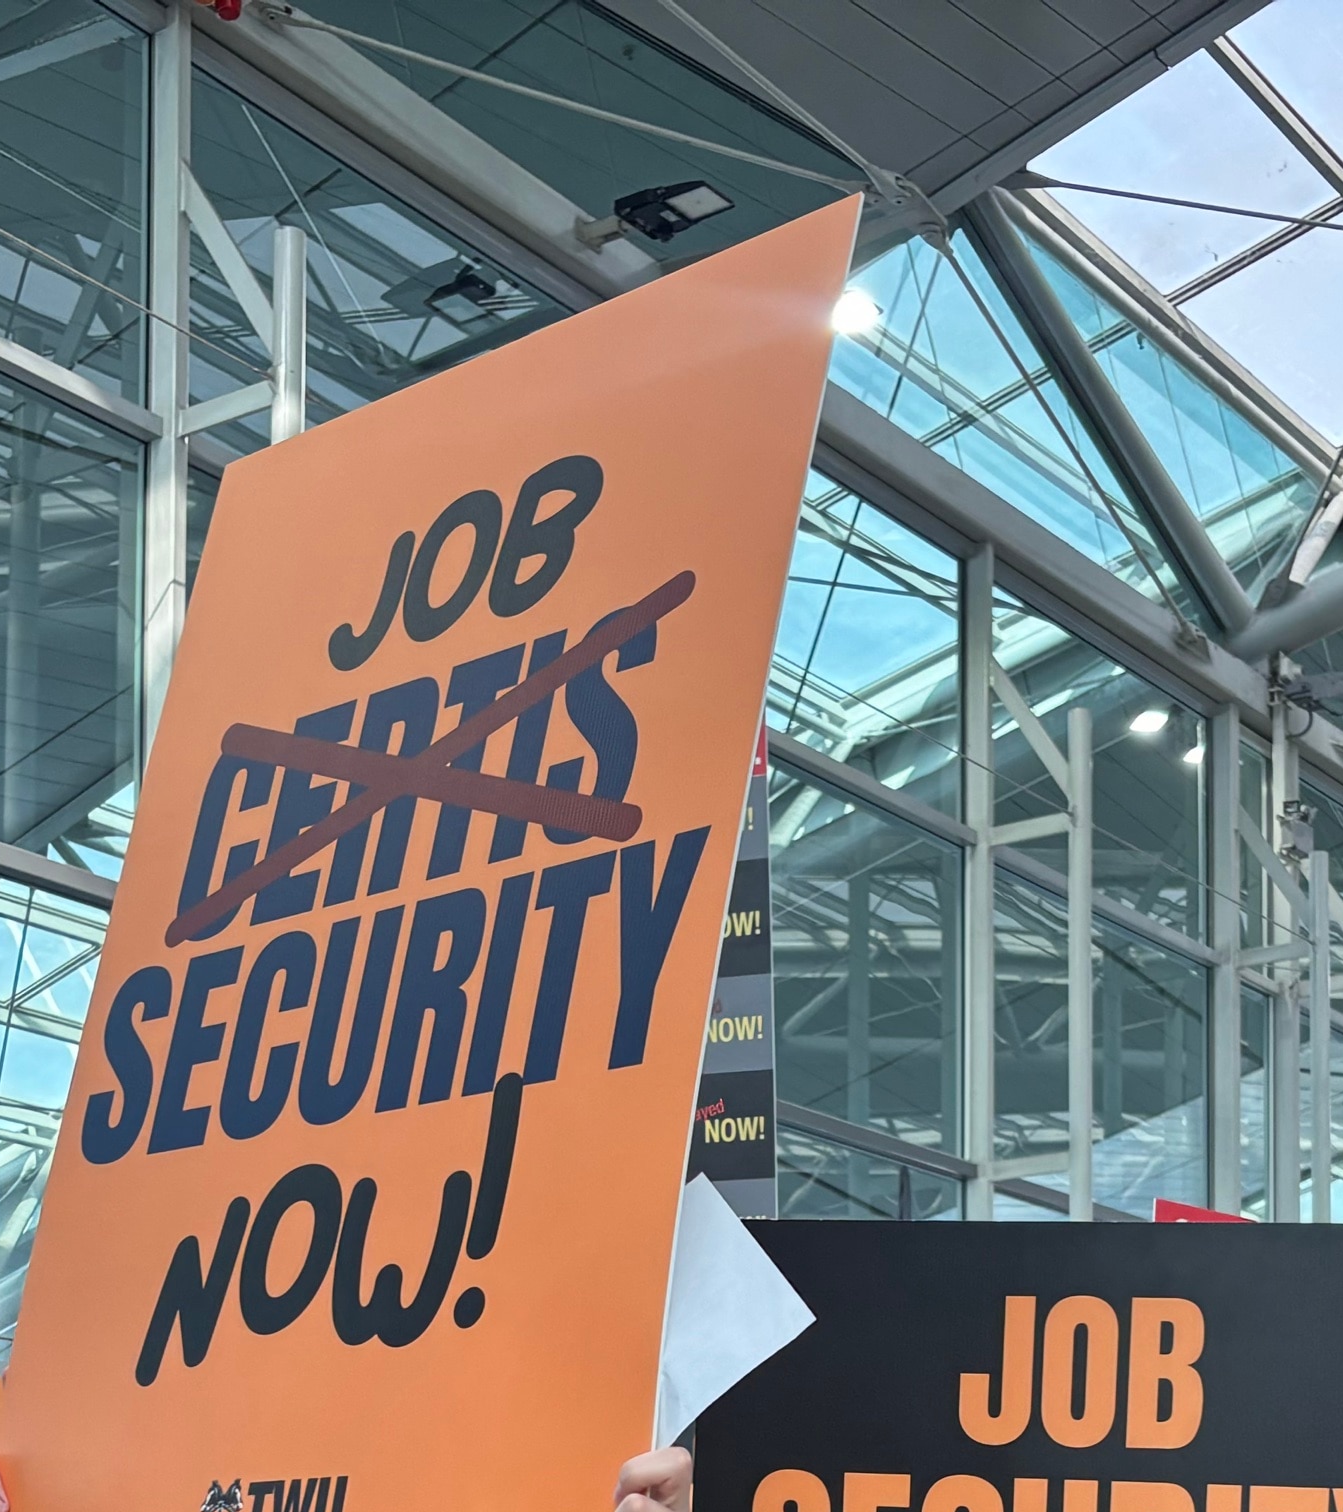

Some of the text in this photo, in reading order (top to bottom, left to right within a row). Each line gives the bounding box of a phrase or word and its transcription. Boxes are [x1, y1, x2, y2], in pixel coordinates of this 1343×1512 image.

[328, 454, 604, 672] JOB
[177, 603, 658, 944] CERTIS
[81, 824, 711, 1167] SECURITY
[134, 1070, 523, 1387] NOW!
[704, 1116, 765, 1143] NOW!
[959, 1294, 1205, 1450] JOB
